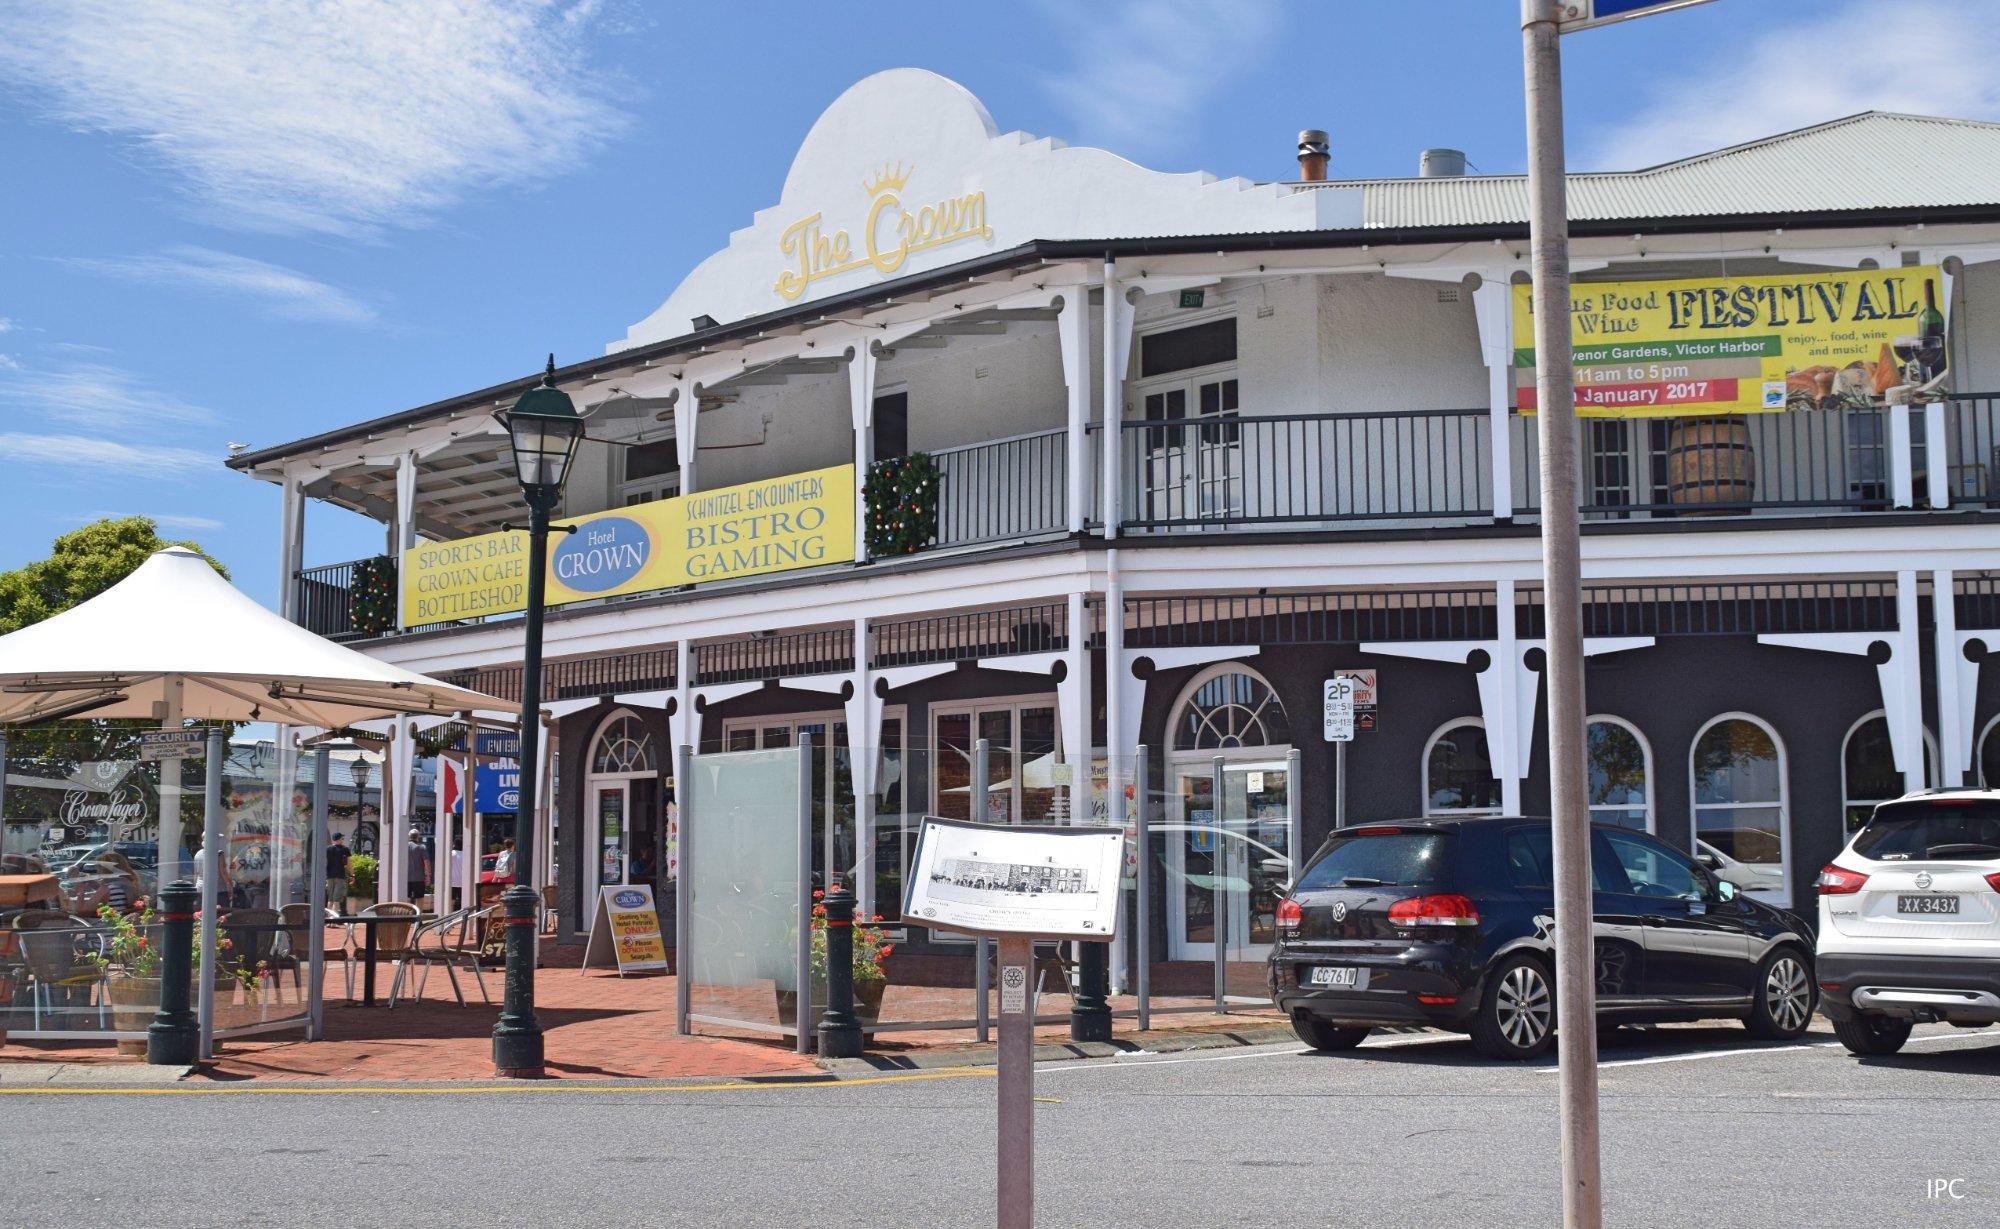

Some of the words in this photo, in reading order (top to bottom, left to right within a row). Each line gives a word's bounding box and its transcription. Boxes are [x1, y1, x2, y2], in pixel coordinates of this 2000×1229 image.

[773, 212, 850, 300] The
[866, 190, 990, 273] Crown
[1184, 294, 1199, 305] EXIT
[1602, 291, 1660, 311] Food
[1667, 278, 1919, 330] FESTIVAL
[1578, 313, 1640, 334] Wine
[1788, 335, 1827, 345] enjoy...
[1831, 331, 1859, 342] food,
[1862, 330, 1887, 340] wine
[1572, 350, 1608, 361] venor
[1612, 346, 1672, 360] Gardens,
[1675, 343, 1716, 356] Victor
[1719, 340, 1766, 353] Harbor
[1809, 346, 1831, 356] and
[1833, 344, 1869, 355] music!
[1627, 366, 1645, 380] to
[1584, 388, 1659, 405] January
[1666, 382, 1708, 400] 2017
[686, 492, 744, 523] SCHNITZEL
[747, 476, 825, 513] ENCOUNTERS
[588, 527, 617, 547] Hotel
[687, 506, 826, 552] BISTRO
[418, 547, 484, 571] SPORTS
[487, 535, 522, 562] BAR
[557, 541, 645, 580] CROWN
[685, 535, 826, 578] GAMING
[417, 567, 480, 594] CROWN
[482, 558, 524, 584] CAFE
[417, 583, 523, 619] BOTTLESHOP
[1328, 685, 1351, 700] 2P
[144, 732, 200, 743] SECURITY
[499, 774, 520, 788] LIV
[67, 791, 107, 824] Crown
[96, 789, 141, 825] Lager
[615, 895, 645, 904] CROWN
